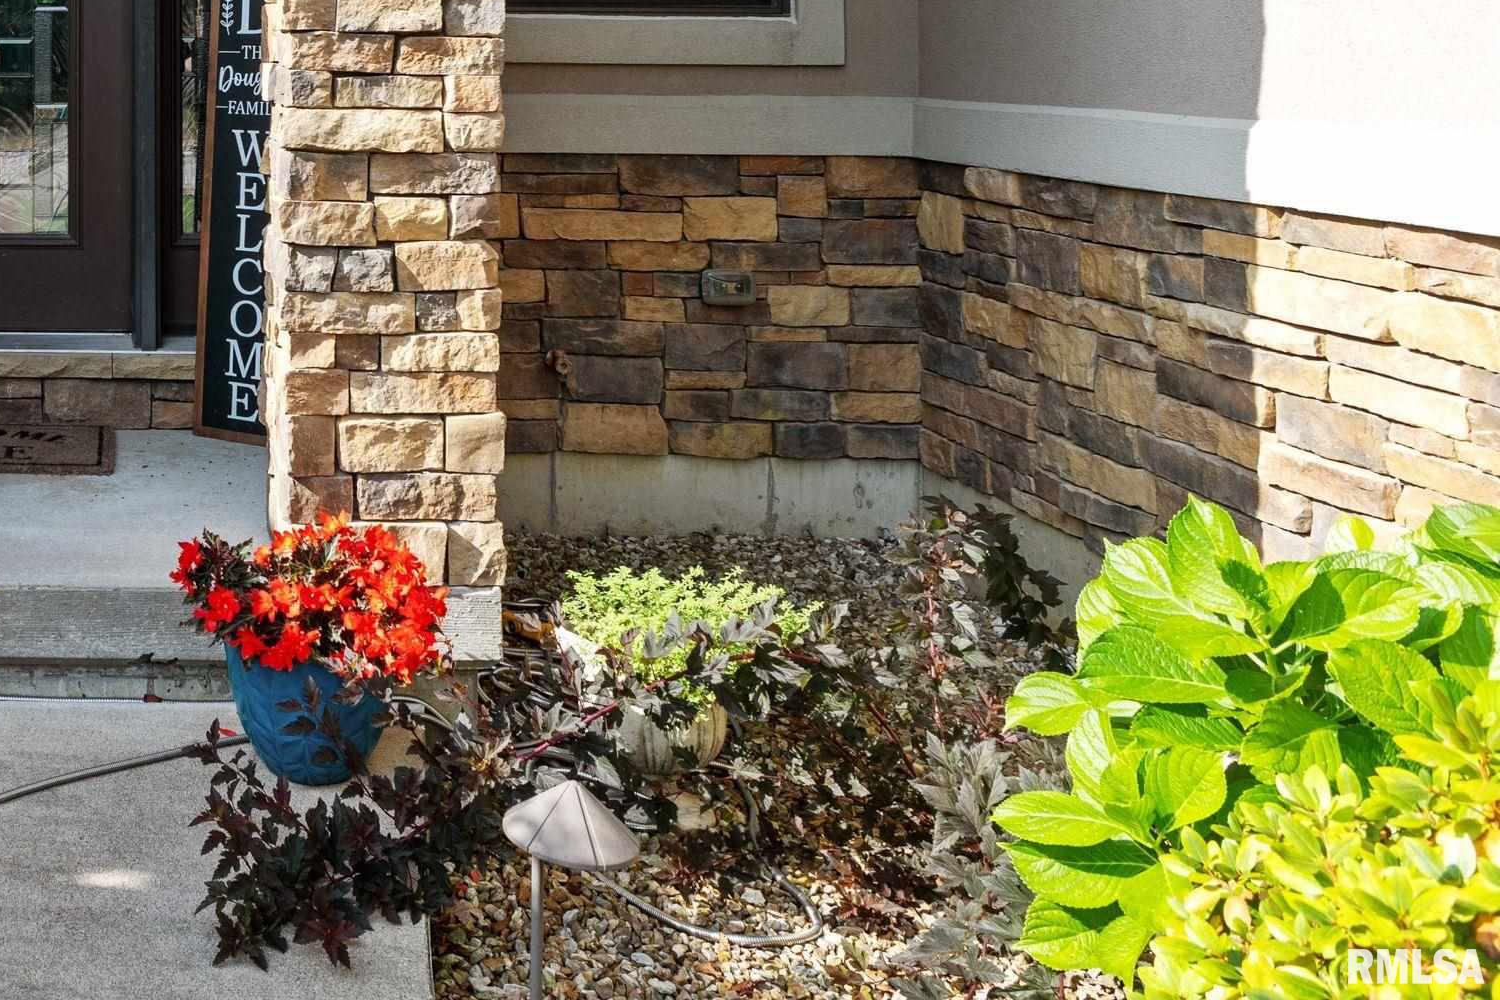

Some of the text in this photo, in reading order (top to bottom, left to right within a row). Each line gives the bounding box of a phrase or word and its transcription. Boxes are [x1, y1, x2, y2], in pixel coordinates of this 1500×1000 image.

[241, 45, 262, 60] TH
[218, 65, 263, 96] Doug
[224, 129, 270, 422] WELCOME
